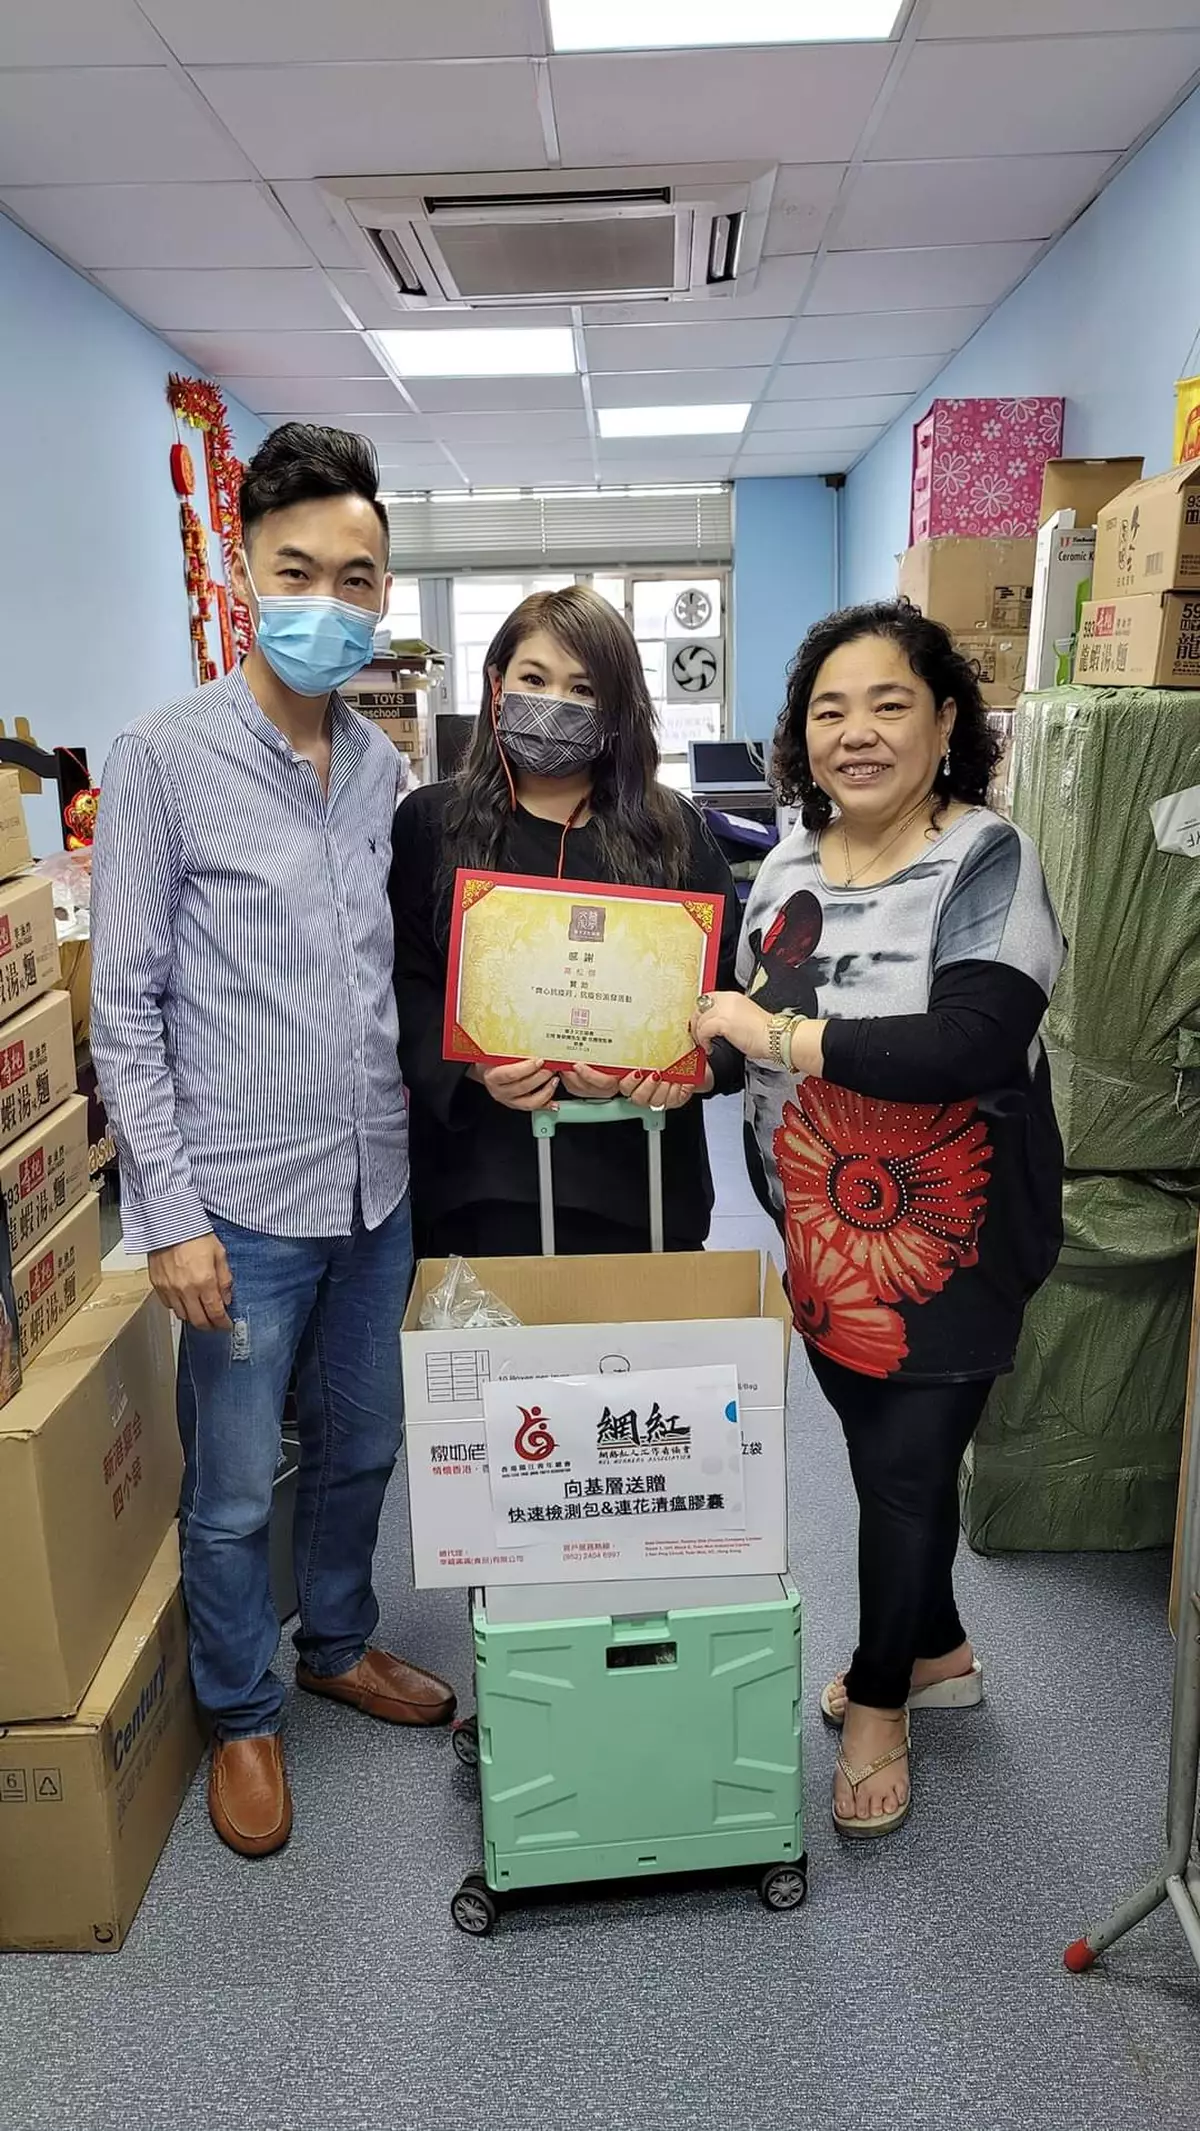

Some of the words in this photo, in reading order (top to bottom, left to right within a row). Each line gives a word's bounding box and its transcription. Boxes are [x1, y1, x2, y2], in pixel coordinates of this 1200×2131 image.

[1058, 551, 1086, 561] Ceramic
[373, 694, 404, 704] TOYS
[597, 1402, 692, 1446] 網紅
[564, 1474, 666, 1498] 向基層送贈
[114, 1654, 167, 1772] Century
